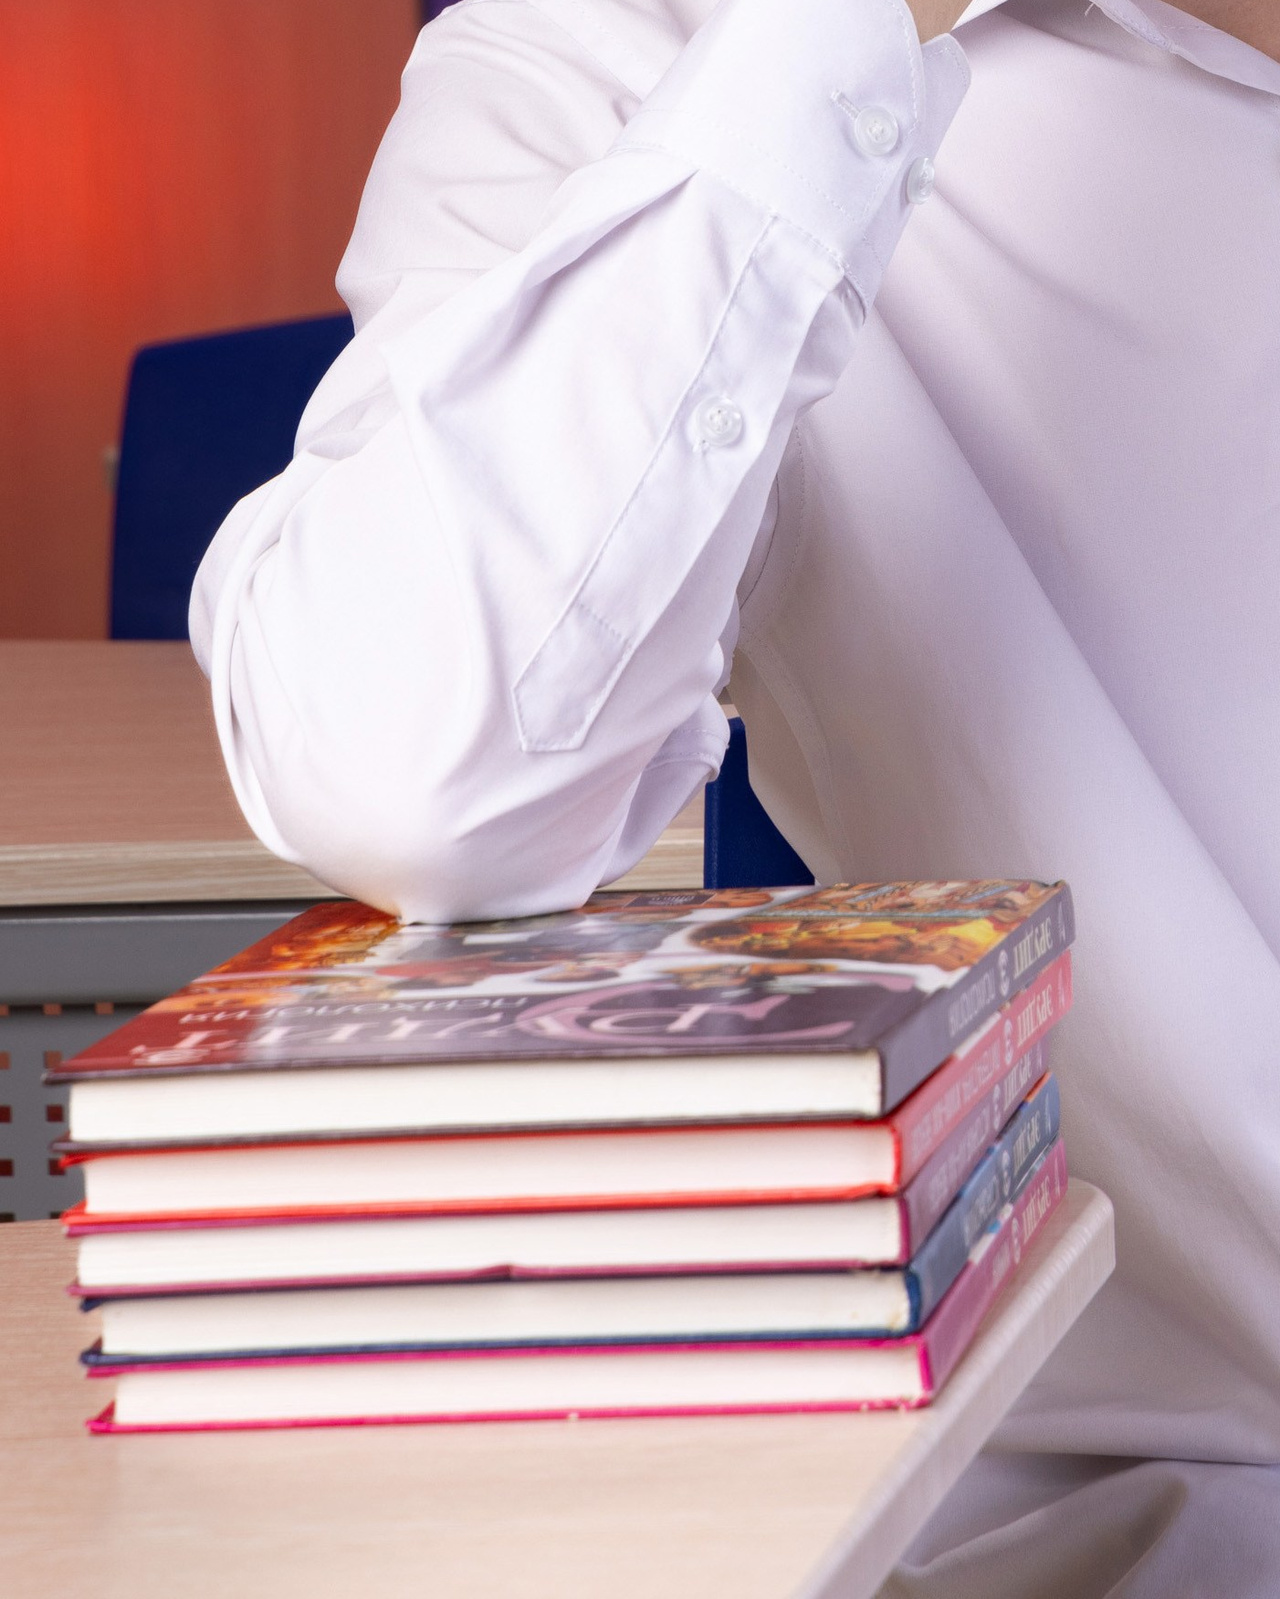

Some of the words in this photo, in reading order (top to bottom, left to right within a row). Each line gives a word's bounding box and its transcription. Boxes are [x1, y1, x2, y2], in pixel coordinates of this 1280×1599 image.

[1012, 914, 1051, 980] ЭРУДИТ
[1016, 981, 1052, 1049] ЭРУДИТ
[1021, 1173, 1050, 1245] ЭРУДИТ
